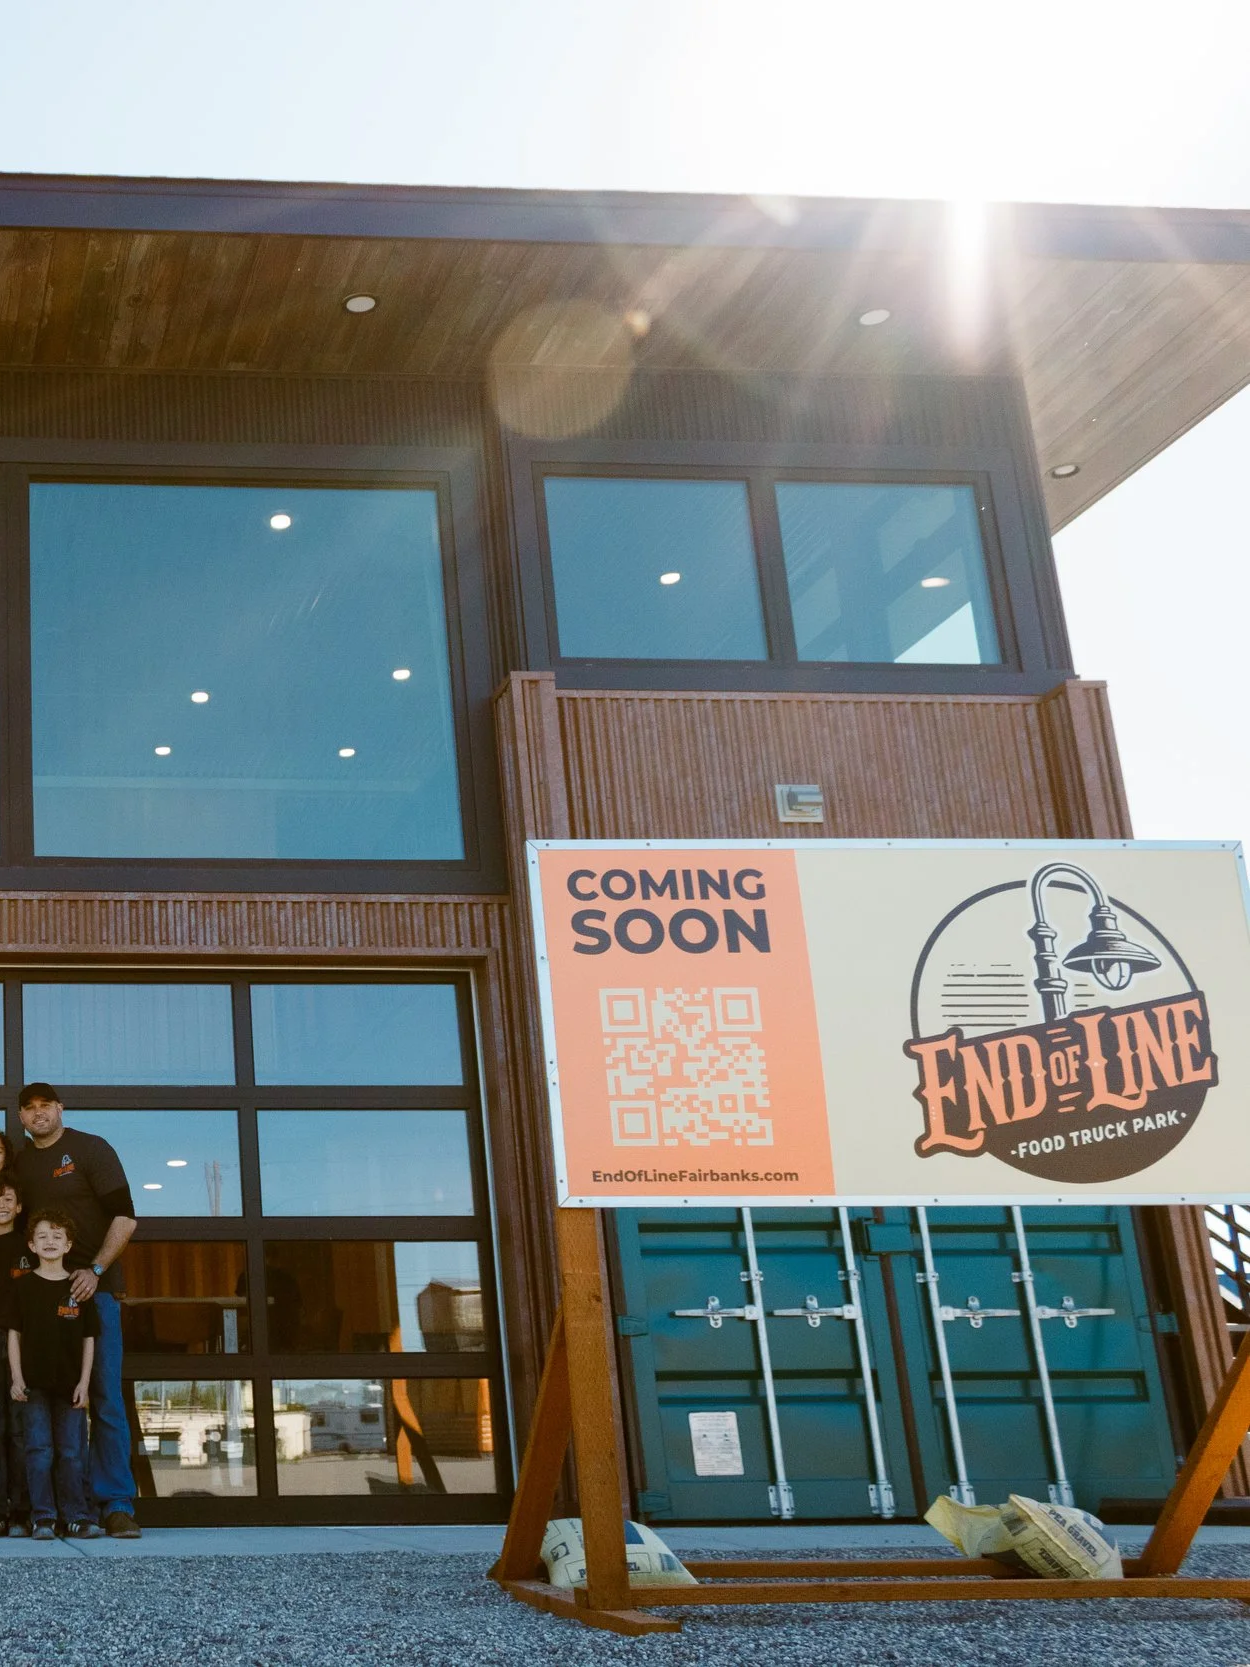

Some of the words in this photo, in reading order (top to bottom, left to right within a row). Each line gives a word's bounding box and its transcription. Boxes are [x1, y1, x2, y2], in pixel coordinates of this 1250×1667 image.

[567, 868, 766, 901] COMING
[571, 908, 771, 955] SOON
[910, 1034, 1047, 1151] END
[1049, 1045, 1081, 1087] OF
[1074, 998, 1211, 1112] LINE
[1069, 1120, 1129, 1147] TRUCK
[592, 1169, 799, 1183] EndOfLineFairbanks.com
[1049, 1509, 1067, 1527] PEA
[1067, 1525, 1098, 1557] GRAVEL
